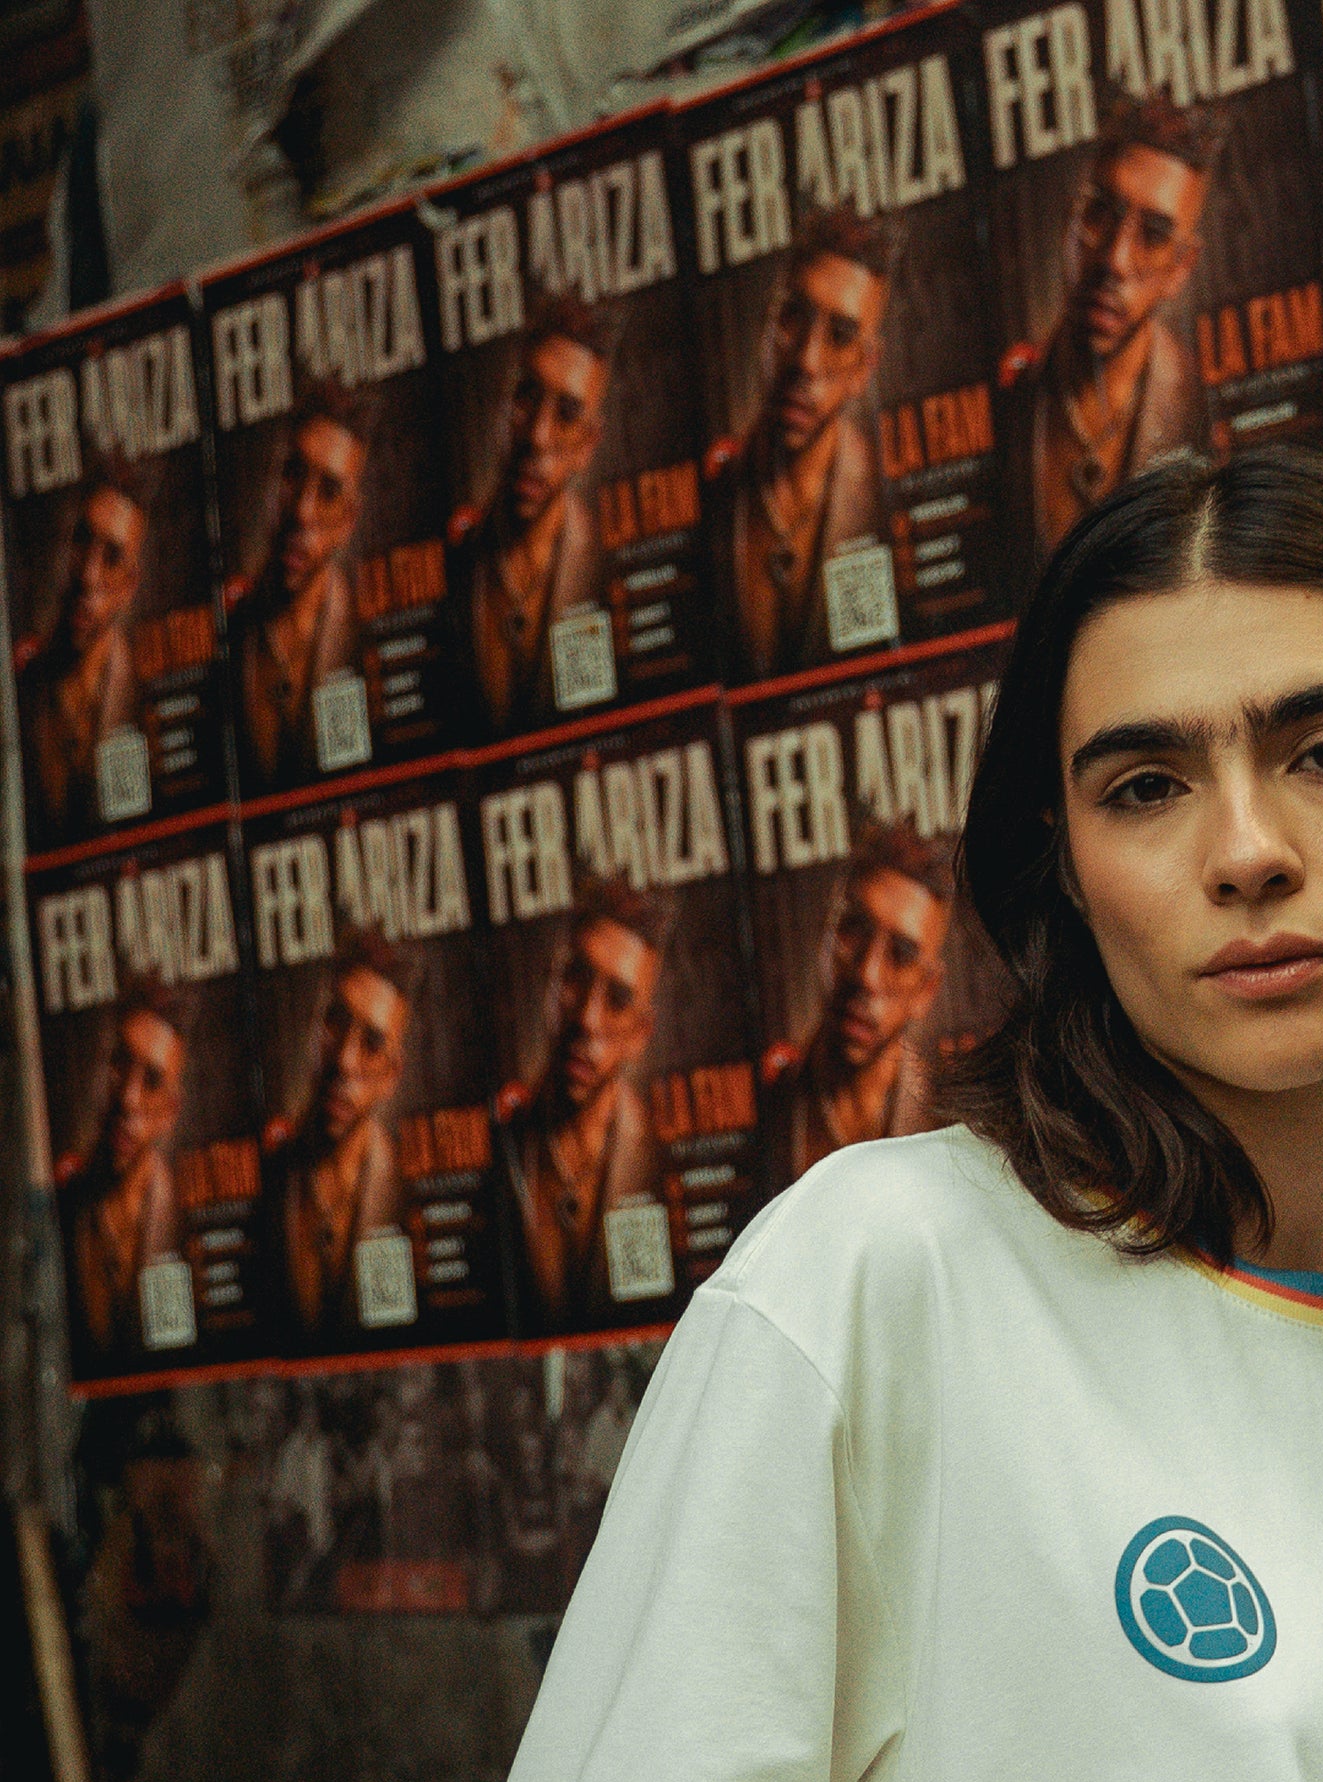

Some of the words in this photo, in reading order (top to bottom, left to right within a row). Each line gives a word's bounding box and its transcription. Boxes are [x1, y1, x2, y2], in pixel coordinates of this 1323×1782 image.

[691, 117, 794, 275] FER
[796, 55, 966, 217] ARIZA
[983, 3, 1098, 168] FER
[433, 205, 526, 352] FER
[526, 150, 677, 302] ARIZA
[1197, 304, 1247, 385] LA
[481, 781, 574, 926] FER
[746, 720, 852, 874] FER
[854, 680, 1000, 840] ARIZ
